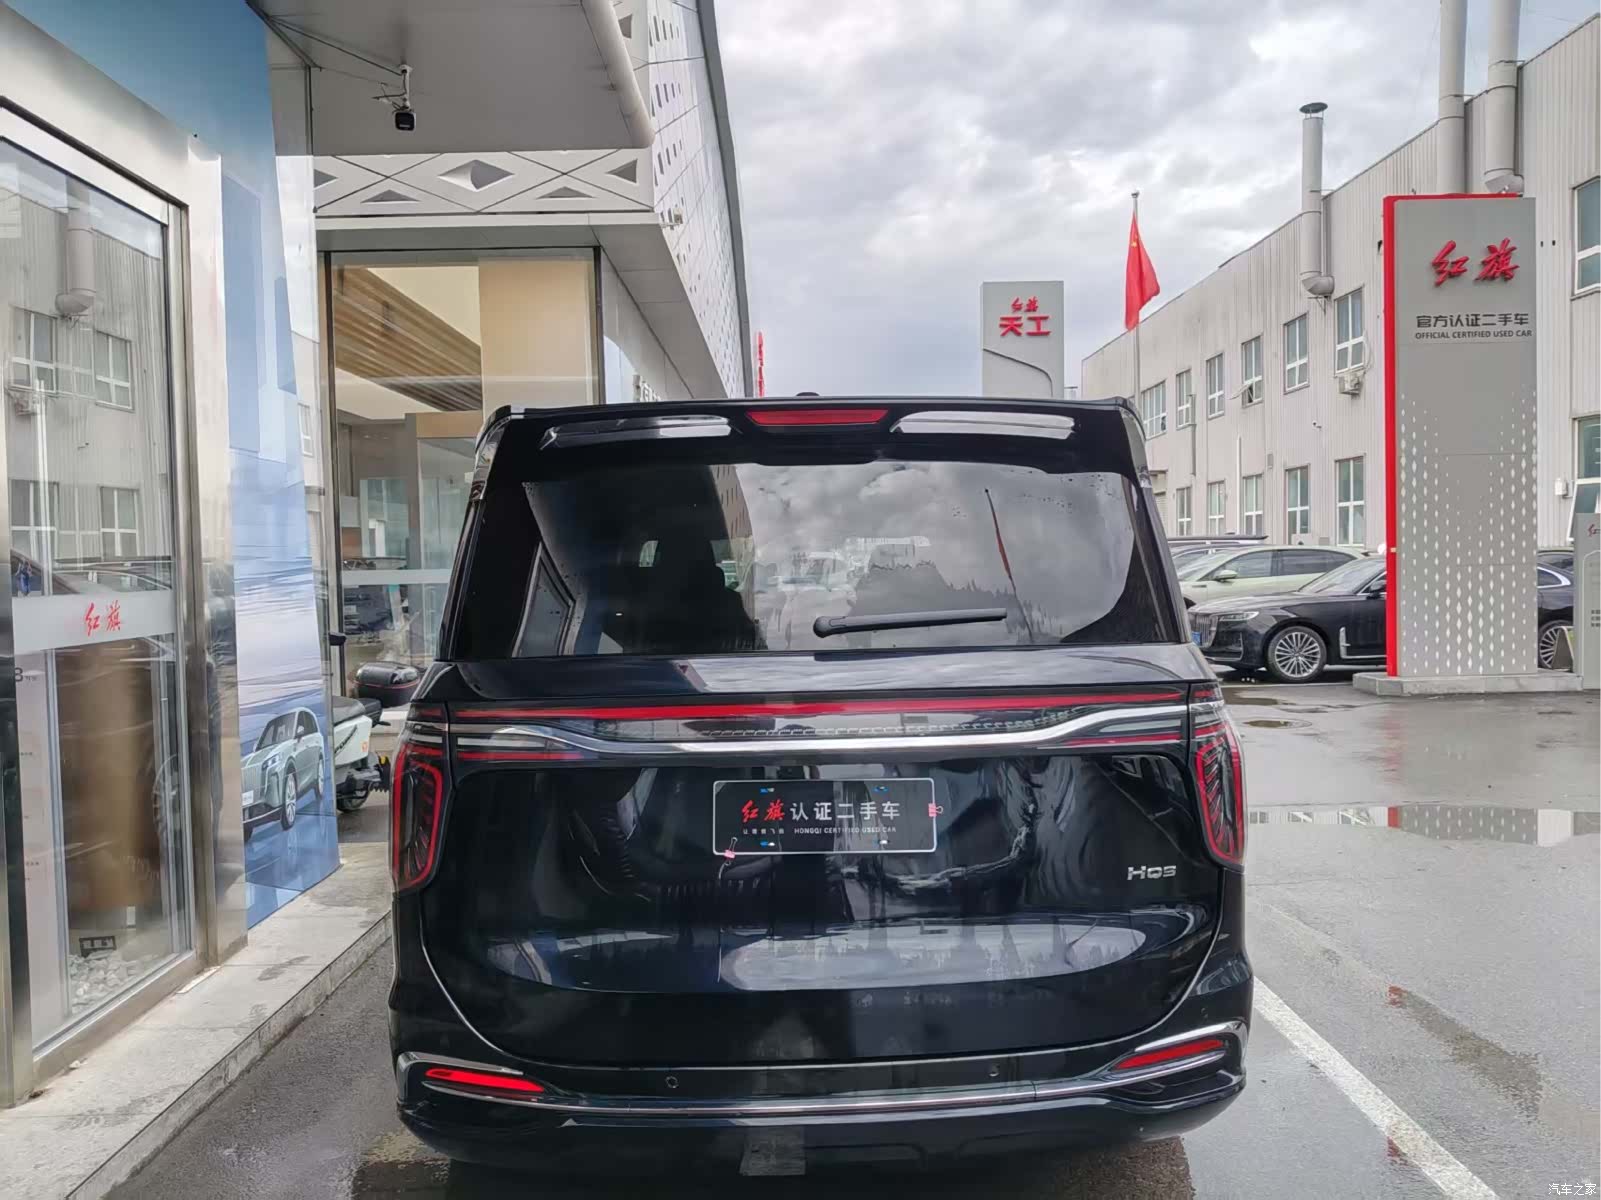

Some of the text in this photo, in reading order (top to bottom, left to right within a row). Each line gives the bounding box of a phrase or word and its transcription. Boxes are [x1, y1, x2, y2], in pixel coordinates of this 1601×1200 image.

[1432, 238, 1520, 287] 红旗
[999, 315, 1052, 336] 天工
[1416, 313, 1529, 328] 官方认证二手车
[1415, 329, 1533, 340] OFFICIAL CERTIFIED USED CAR
[84, 600, 121, 637] 红旗
[794, 827, 822, 835] HONGQI
